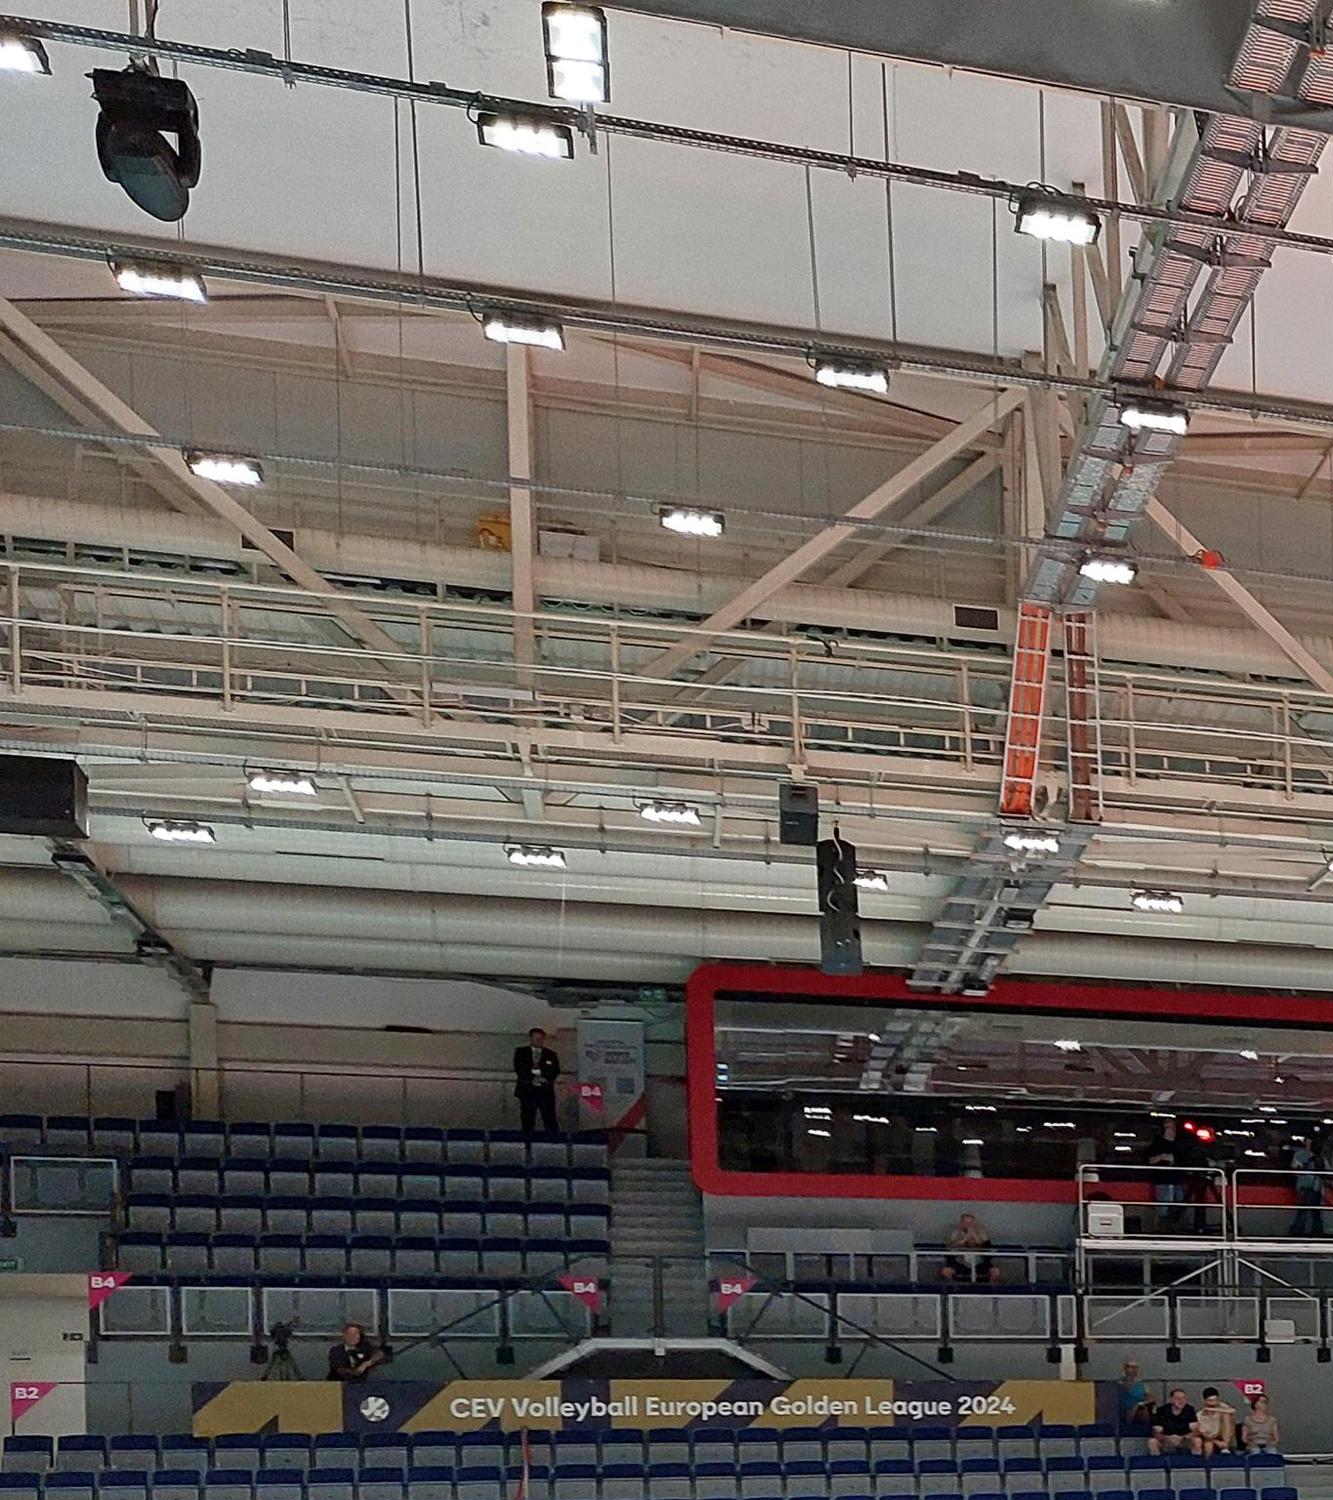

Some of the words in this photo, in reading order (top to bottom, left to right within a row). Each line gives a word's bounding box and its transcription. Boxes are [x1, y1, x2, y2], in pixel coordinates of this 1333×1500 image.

[90, 1276, 116, 1289] B4
[573, 1282, 595, 1294] B4
[720, 1283, 742, 1295] B4
[14, 1386, 39, 1400] B2
[450, 1398, 504, 1419] CEV
[510, 1396, 638, 1422] Volleyball
[645, 1397, 764, 1422] European
[769, 1395, 858, 1417] Golden
[864, 1395, 952, 1422] League
[957, 1395, 1016, 1416] 2024
